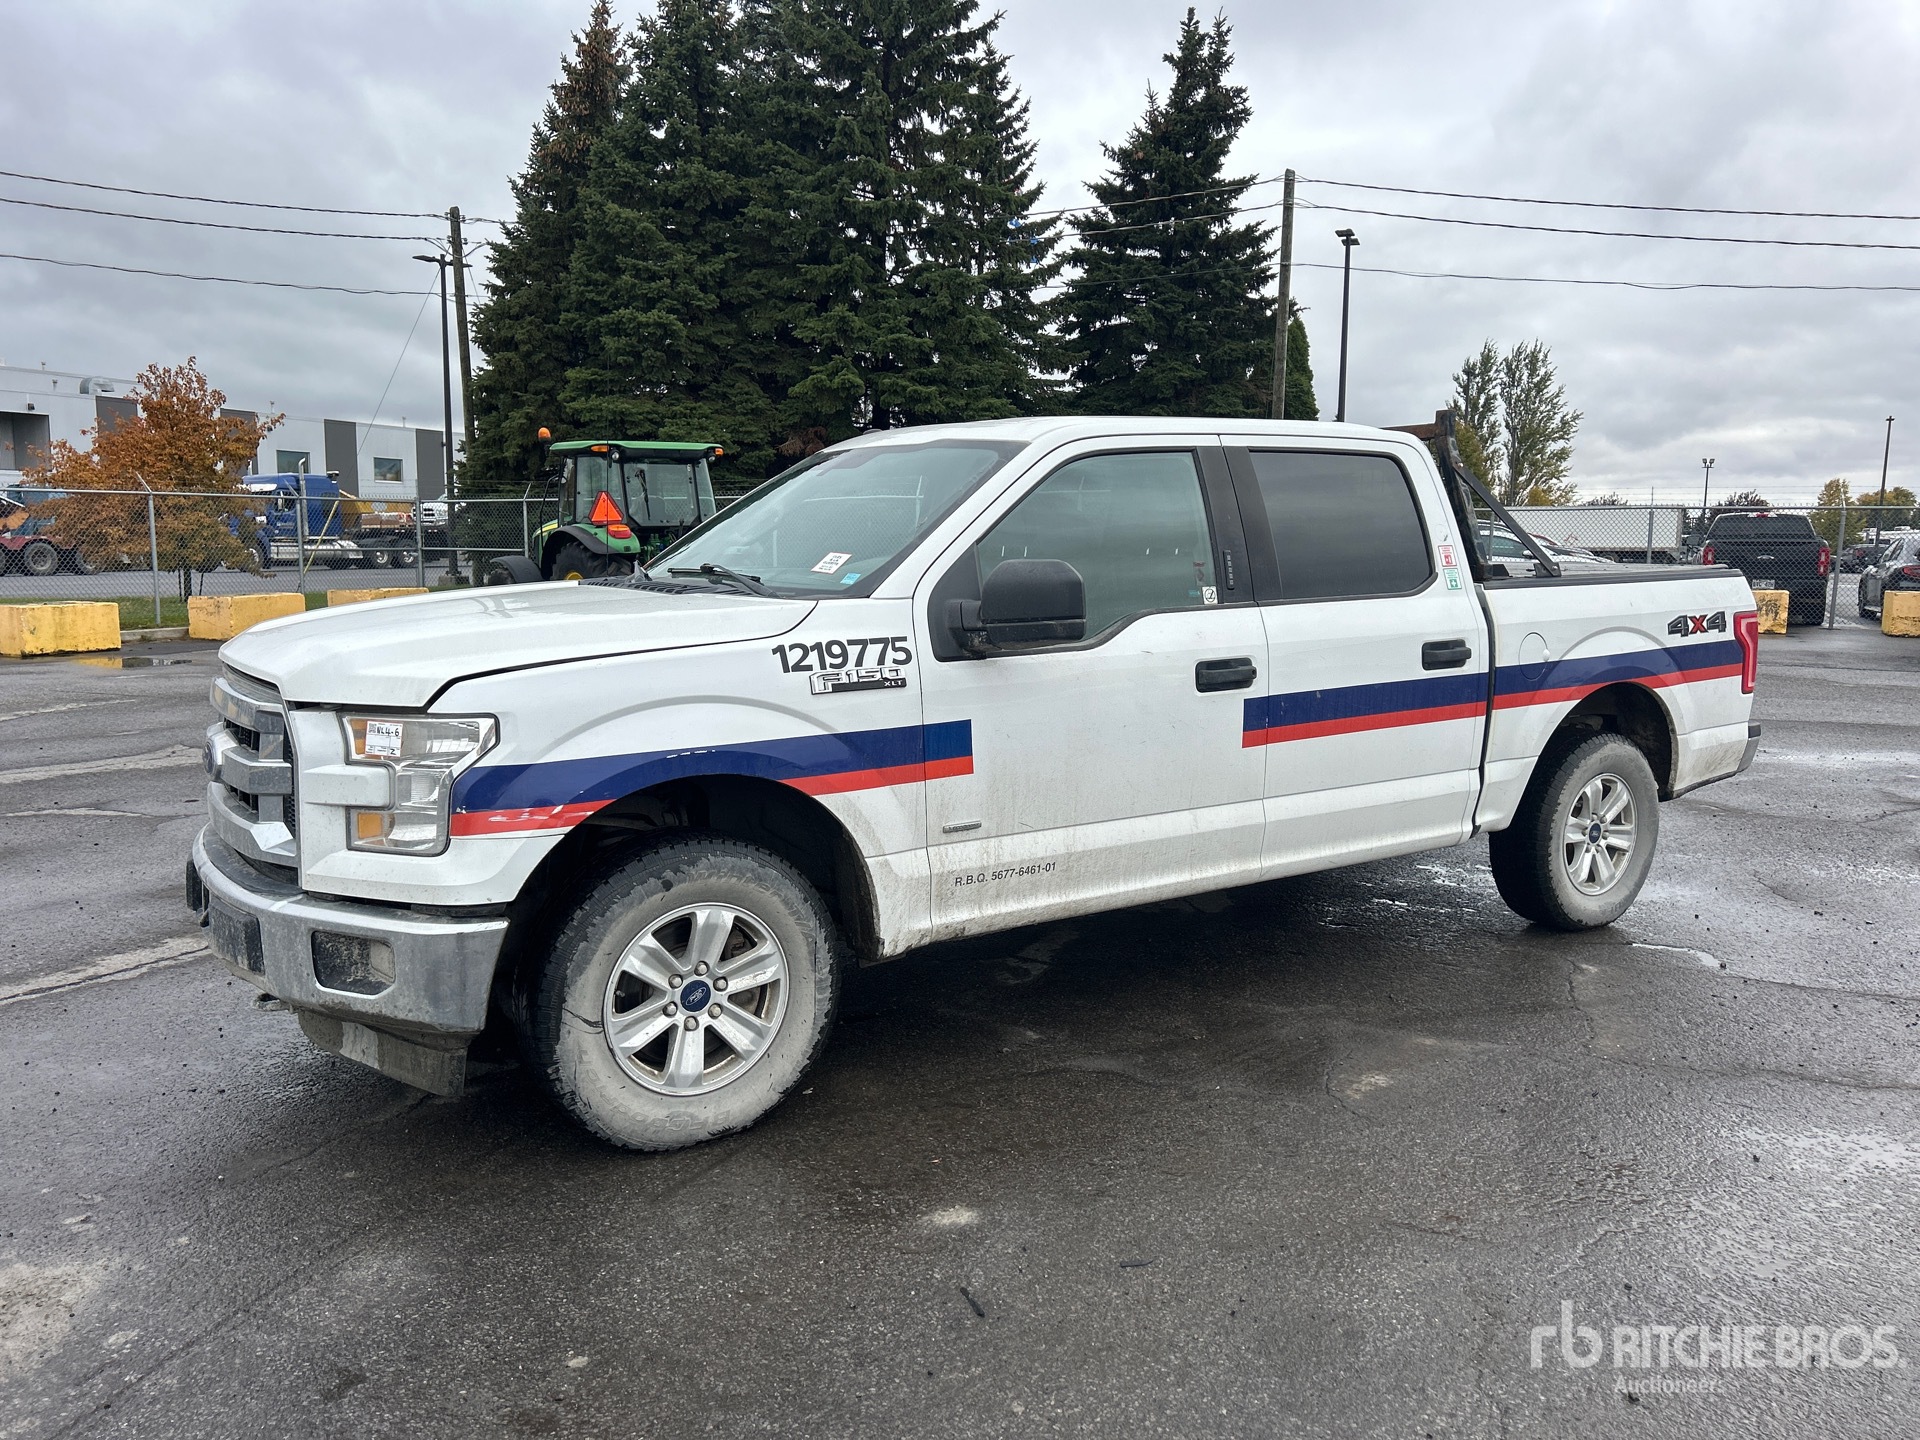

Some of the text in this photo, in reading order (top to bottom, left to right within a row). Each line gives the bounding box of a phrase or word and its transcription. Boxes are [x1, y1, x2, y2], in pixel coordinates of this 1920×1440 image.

[771, 636, 913, 673] 1219775
[883, 679, 903, 687] XLT
[954, 862, 1057, 887] R.B.Q. 5677-6461-01
